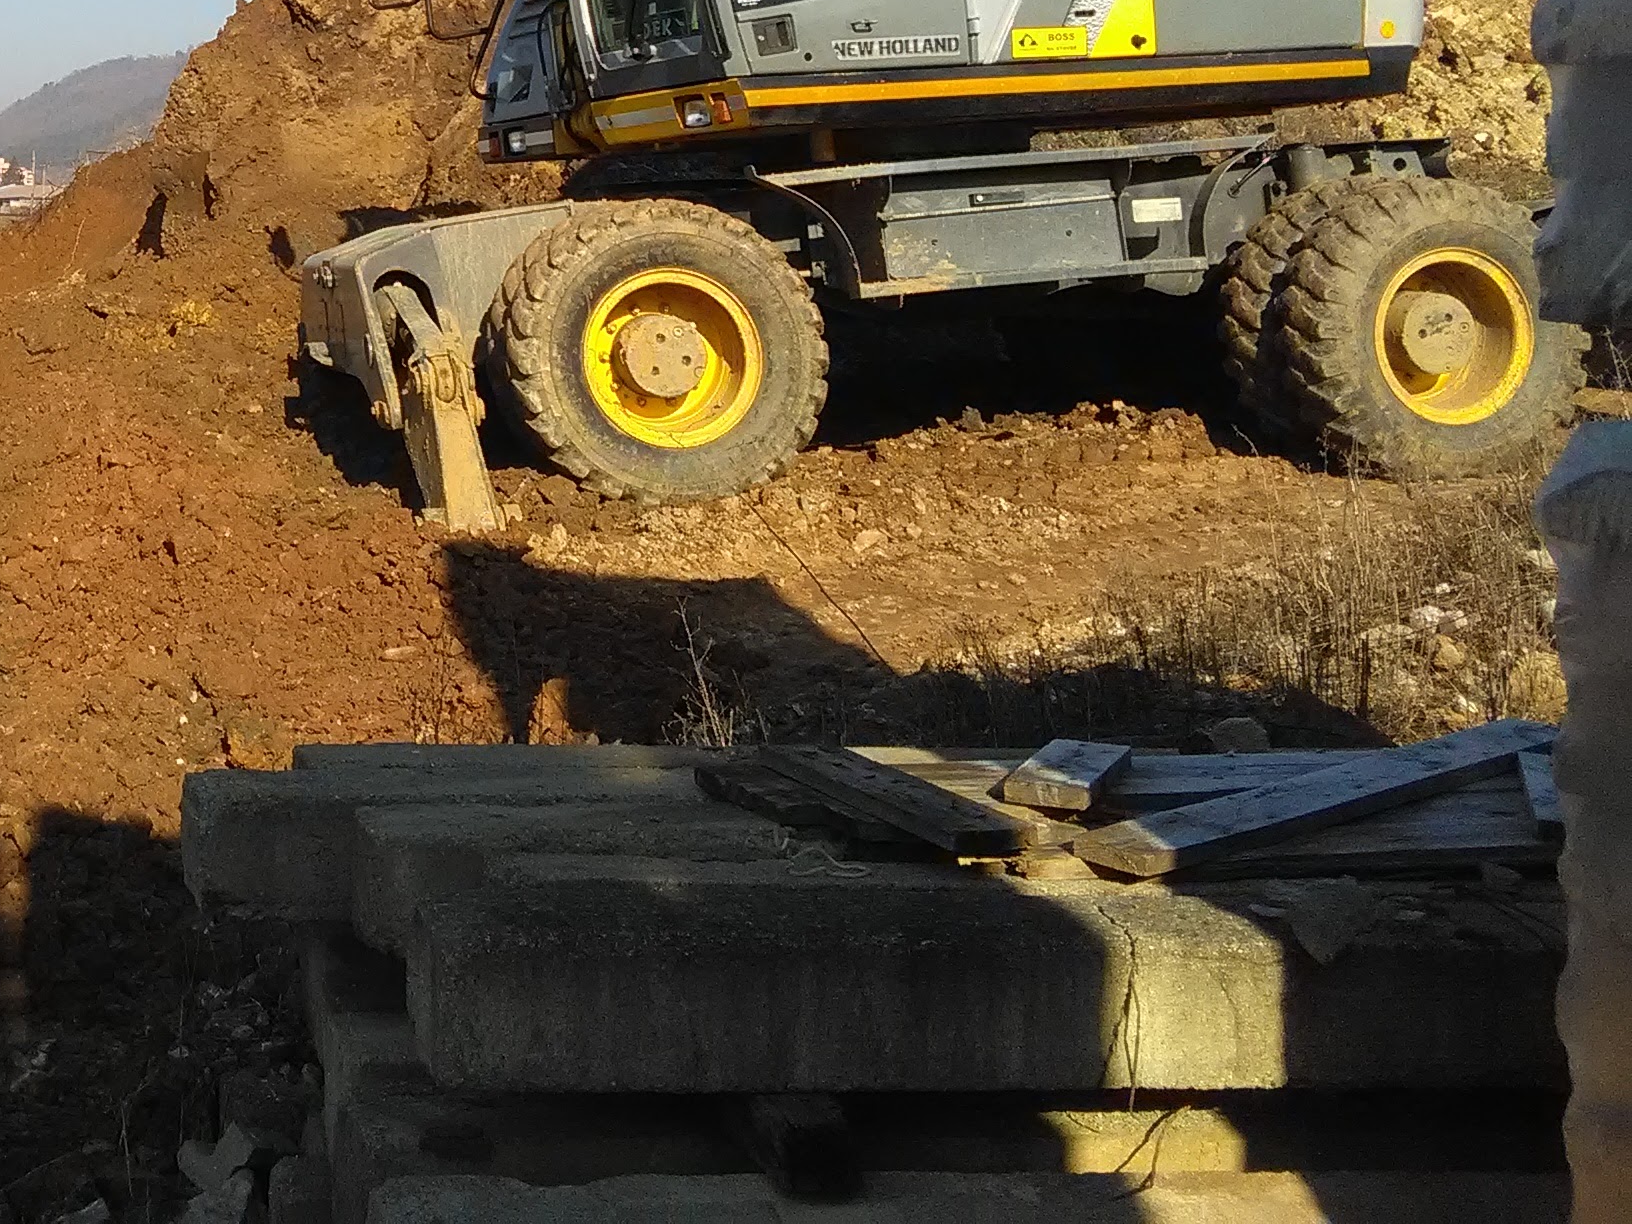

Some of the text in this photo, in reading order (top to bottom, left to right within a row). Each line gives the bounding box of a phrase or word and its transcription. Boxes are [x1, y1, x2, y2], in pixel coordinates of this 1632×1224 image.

[1047, 32, 1076, 42] BOSS
[833, 36, 960, 57] NEW HOLLAND
